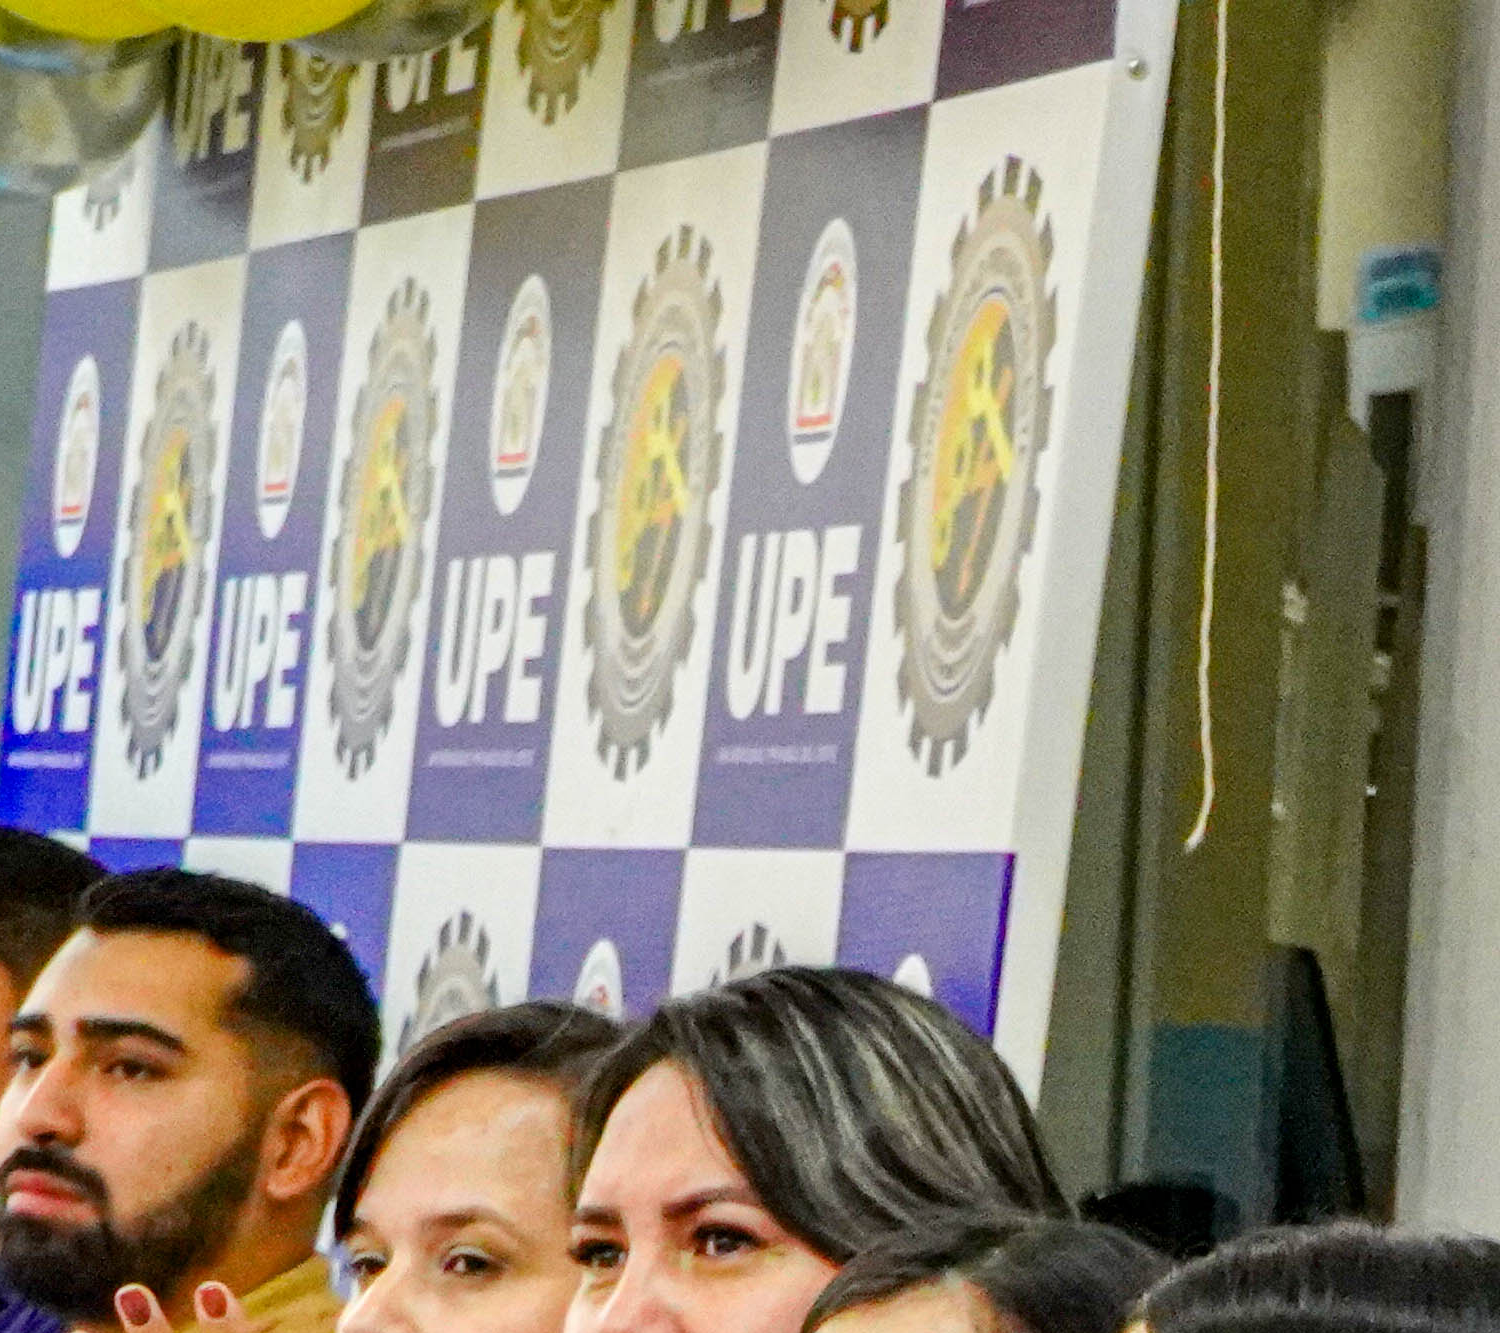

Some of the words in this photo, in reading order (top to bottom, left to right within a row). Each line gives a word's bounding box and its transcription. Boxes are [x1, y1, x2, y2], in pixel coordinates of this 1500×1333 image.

[13, 588, 101, 734] UPE
[213, 571, 308, 732] UPE
[435, 552, 556, 726] UPE
[727, 525, 863, 721] UPE
